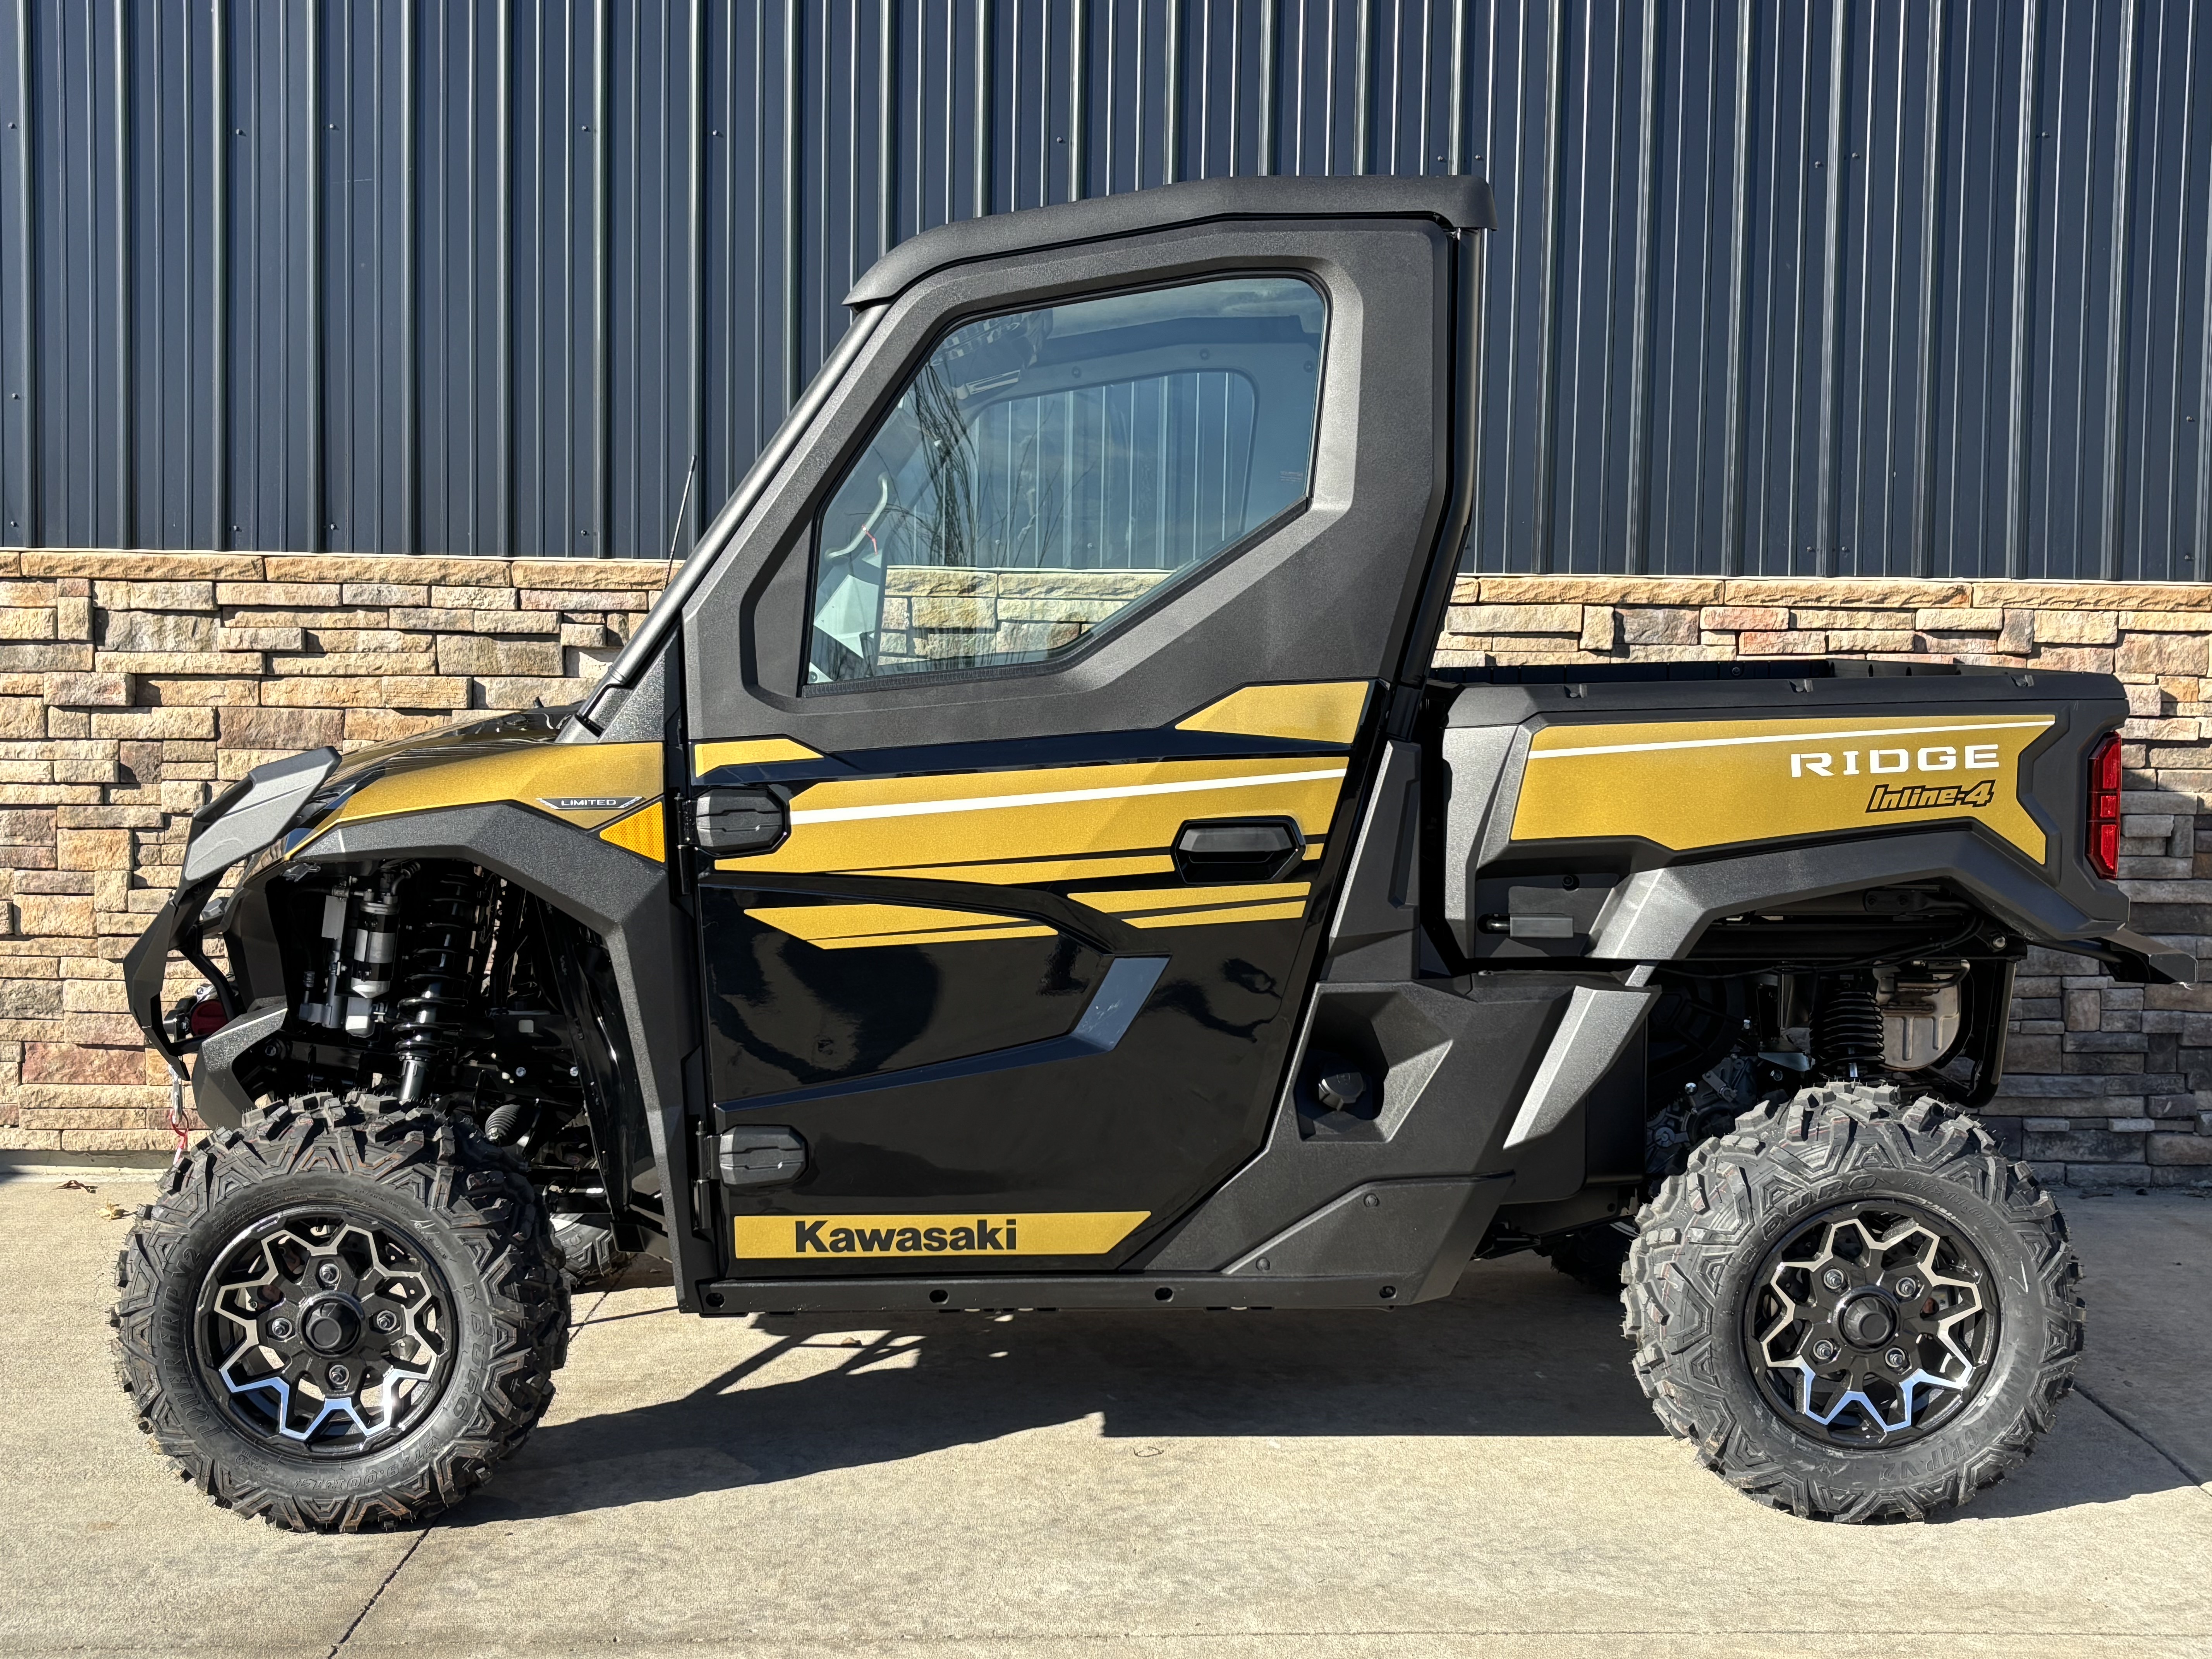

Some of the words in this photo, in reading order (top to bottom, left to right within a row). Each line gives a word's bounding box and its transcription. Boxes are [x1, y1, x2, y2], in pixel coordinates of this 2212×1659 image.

[1791, 744, 1999, 778] RIDGE
[1865, 780, 1996, 813] Inline-4
[1761, 1174, 1877, 1241] DURO
[795, 1219, 1017, 1253] Kawasaki
[171, 1247, 202, 1278] V2
[160, 1286, 183, 1350] GRIP
[453, 1313, 484, 1418] DURO
[163, 1357, 222, 1439] POWER
[1882, 1461, 1920, 1480] V2
